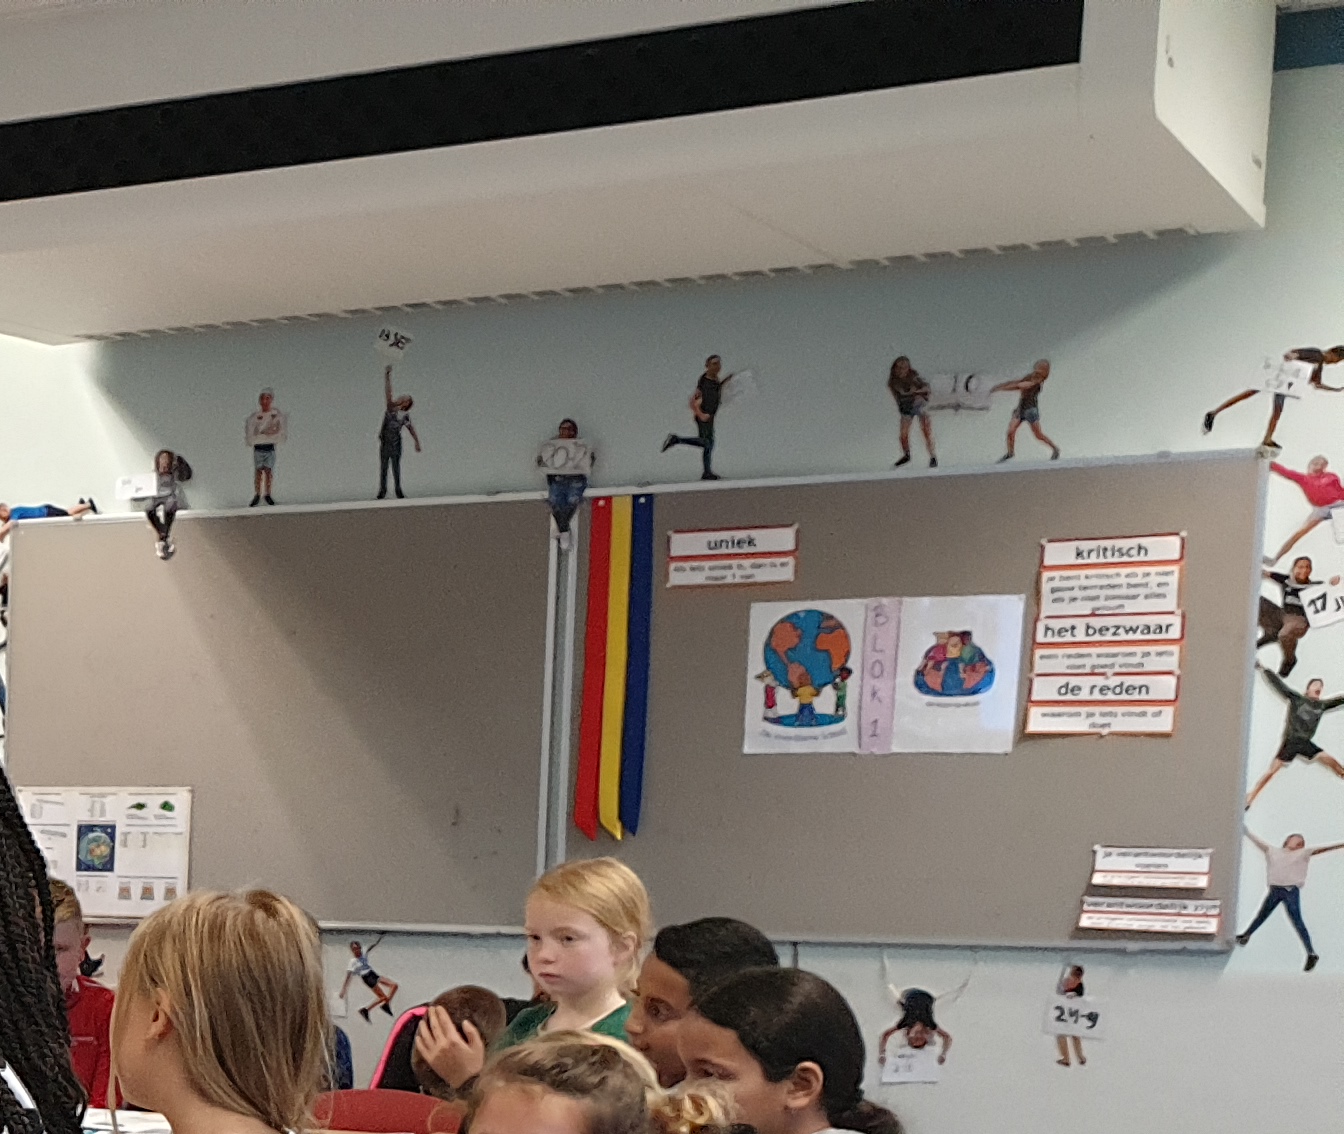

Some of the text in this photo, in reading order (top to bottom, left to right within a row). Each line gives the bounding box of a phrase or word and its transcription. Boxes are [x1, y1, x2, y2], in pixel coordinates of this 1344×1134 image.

[706, 534, 757, 551] uniek
[1075, 543, 1149, 560] kritisch
[1043, 621, 1175, 639] het bezwaar
[1057, 680, 1150, 697] de reden
